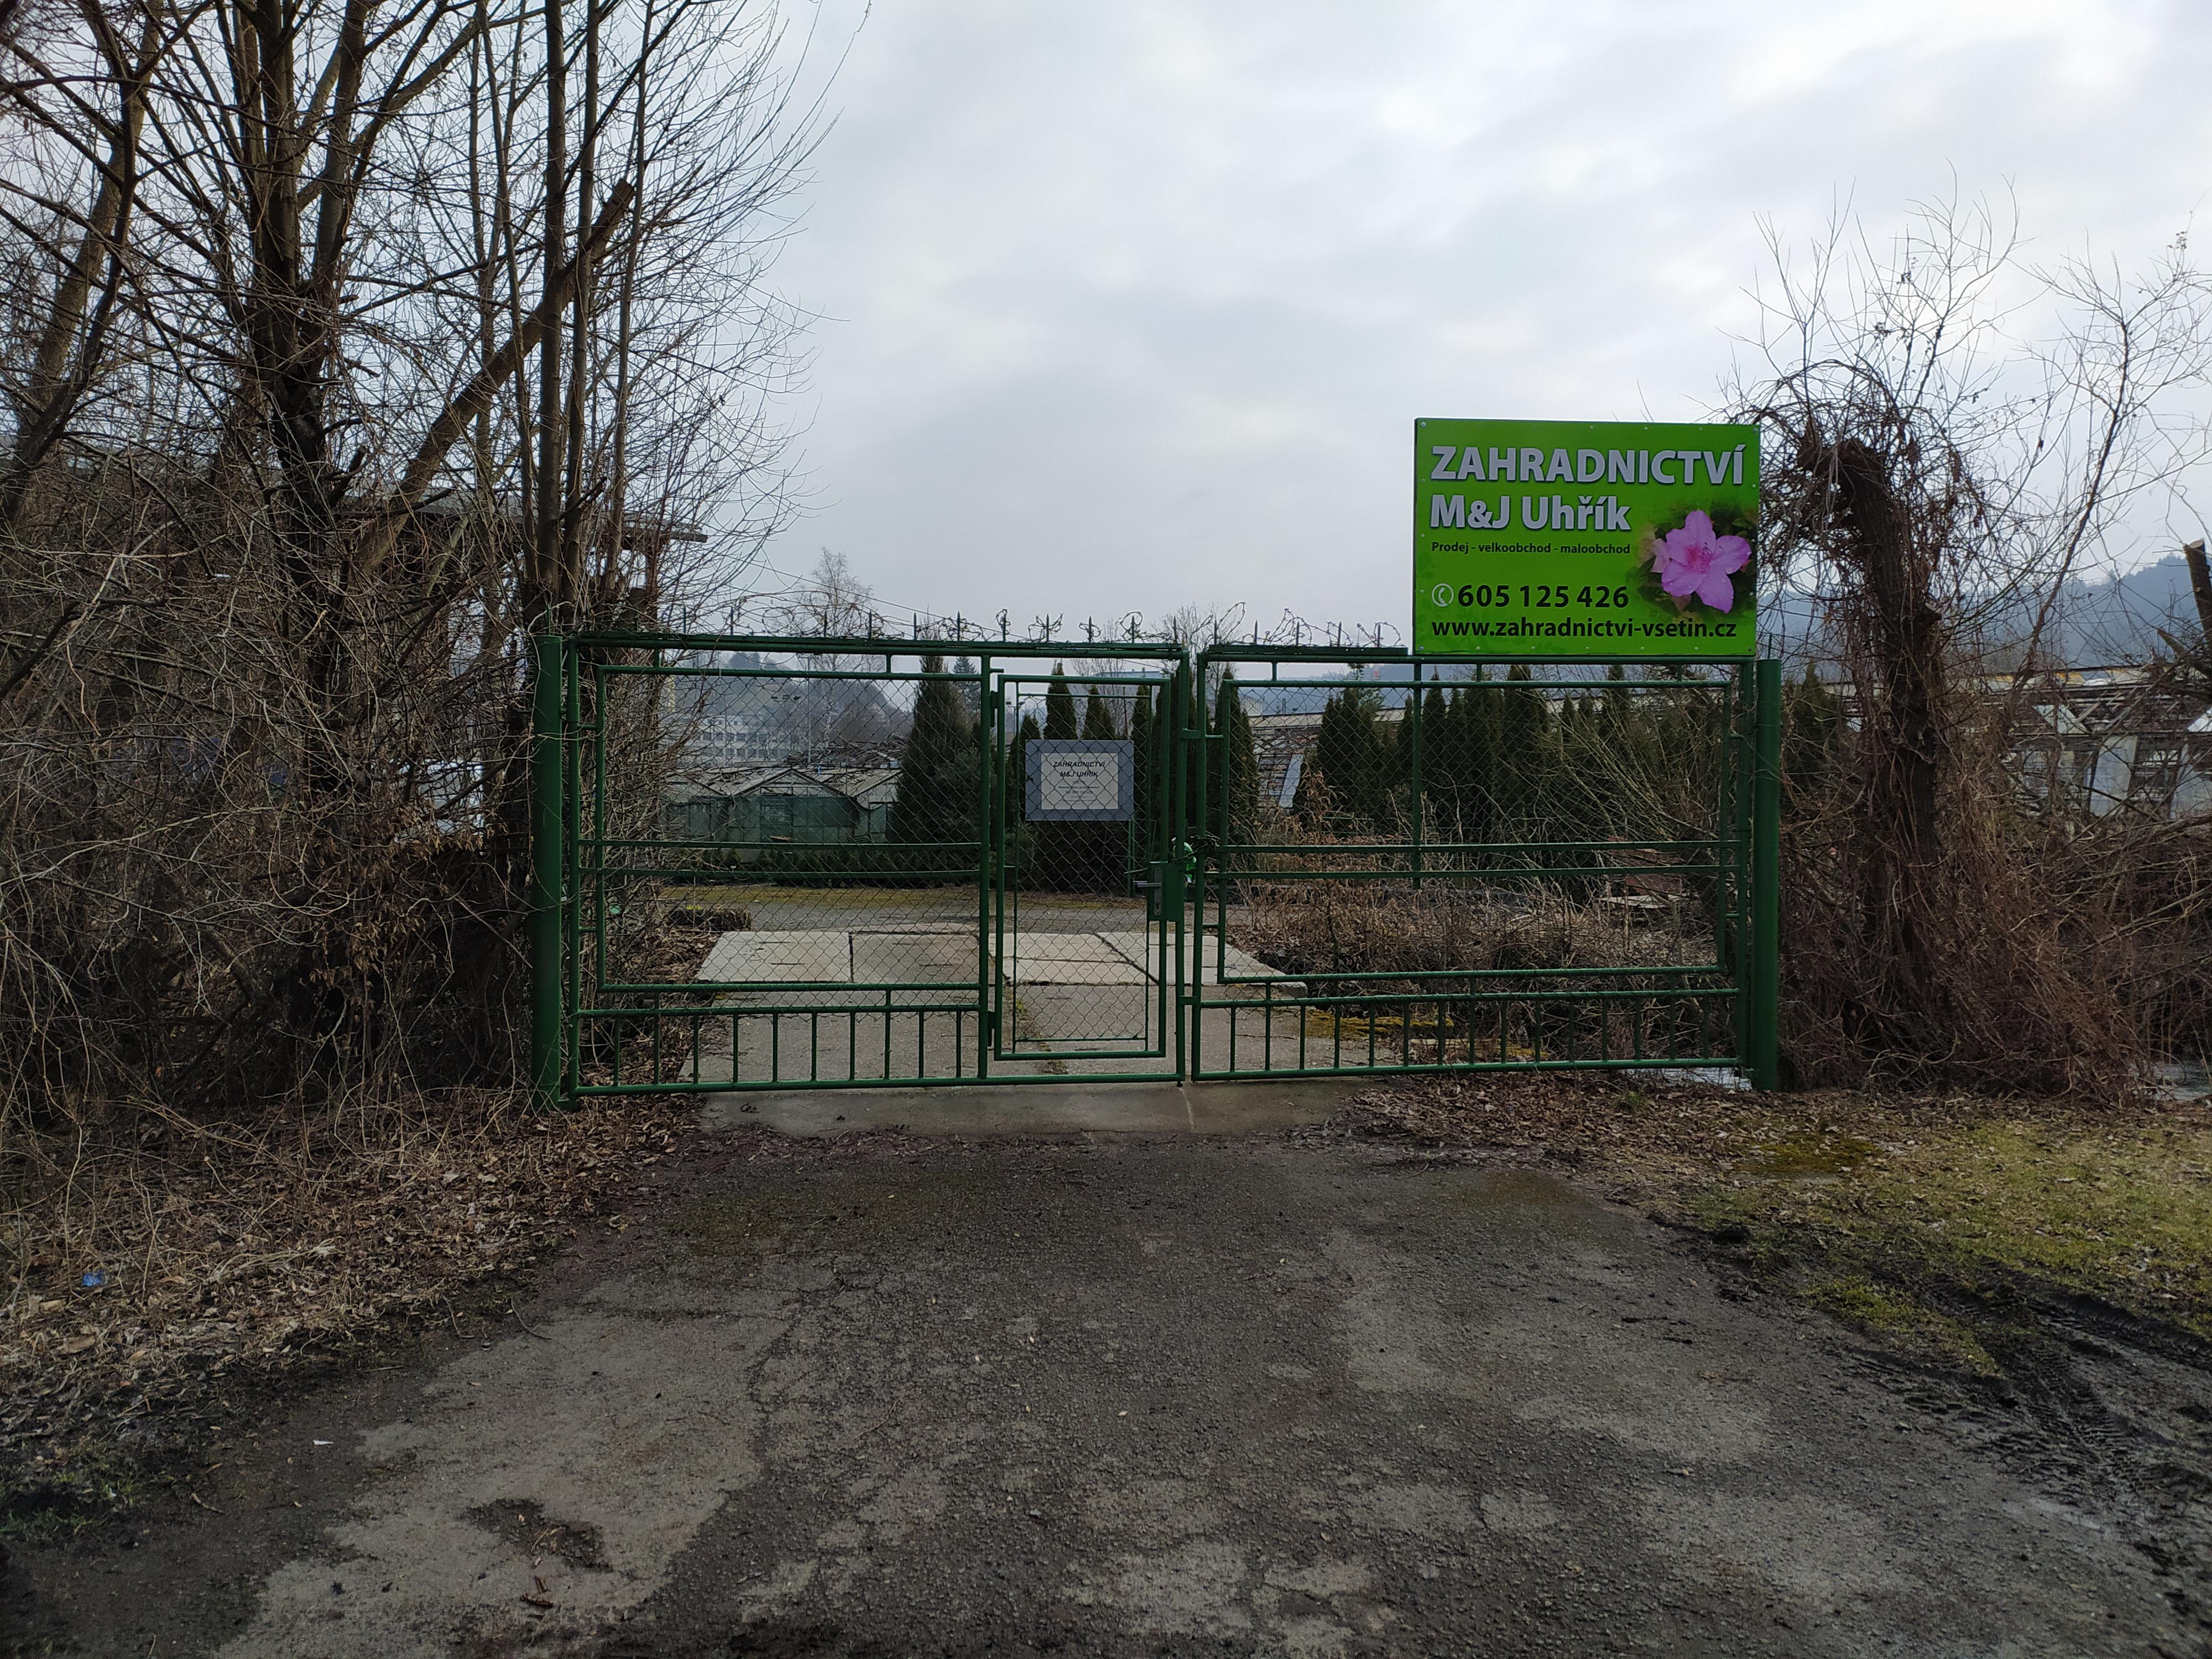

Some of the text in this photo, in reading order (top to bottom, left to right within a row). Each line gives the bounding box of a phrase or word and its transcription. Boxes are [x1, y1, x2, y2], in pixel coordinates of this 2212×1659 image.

[1431, 445, 1746, 484] ZAHRADNICTVÍ
[1430, 495, 1631, 530] M&J Uhřík
[1432, 541, 1469, 554] Prodej
[1478, 542, 1551, 553] velkoobchod
[1561, 543, 1630, 555] maloobchod
[1458, 584, 1629, 608] 605 125 426
[1432, 618, 1736, 637] www.zahradnictvi-vsetin.cz
